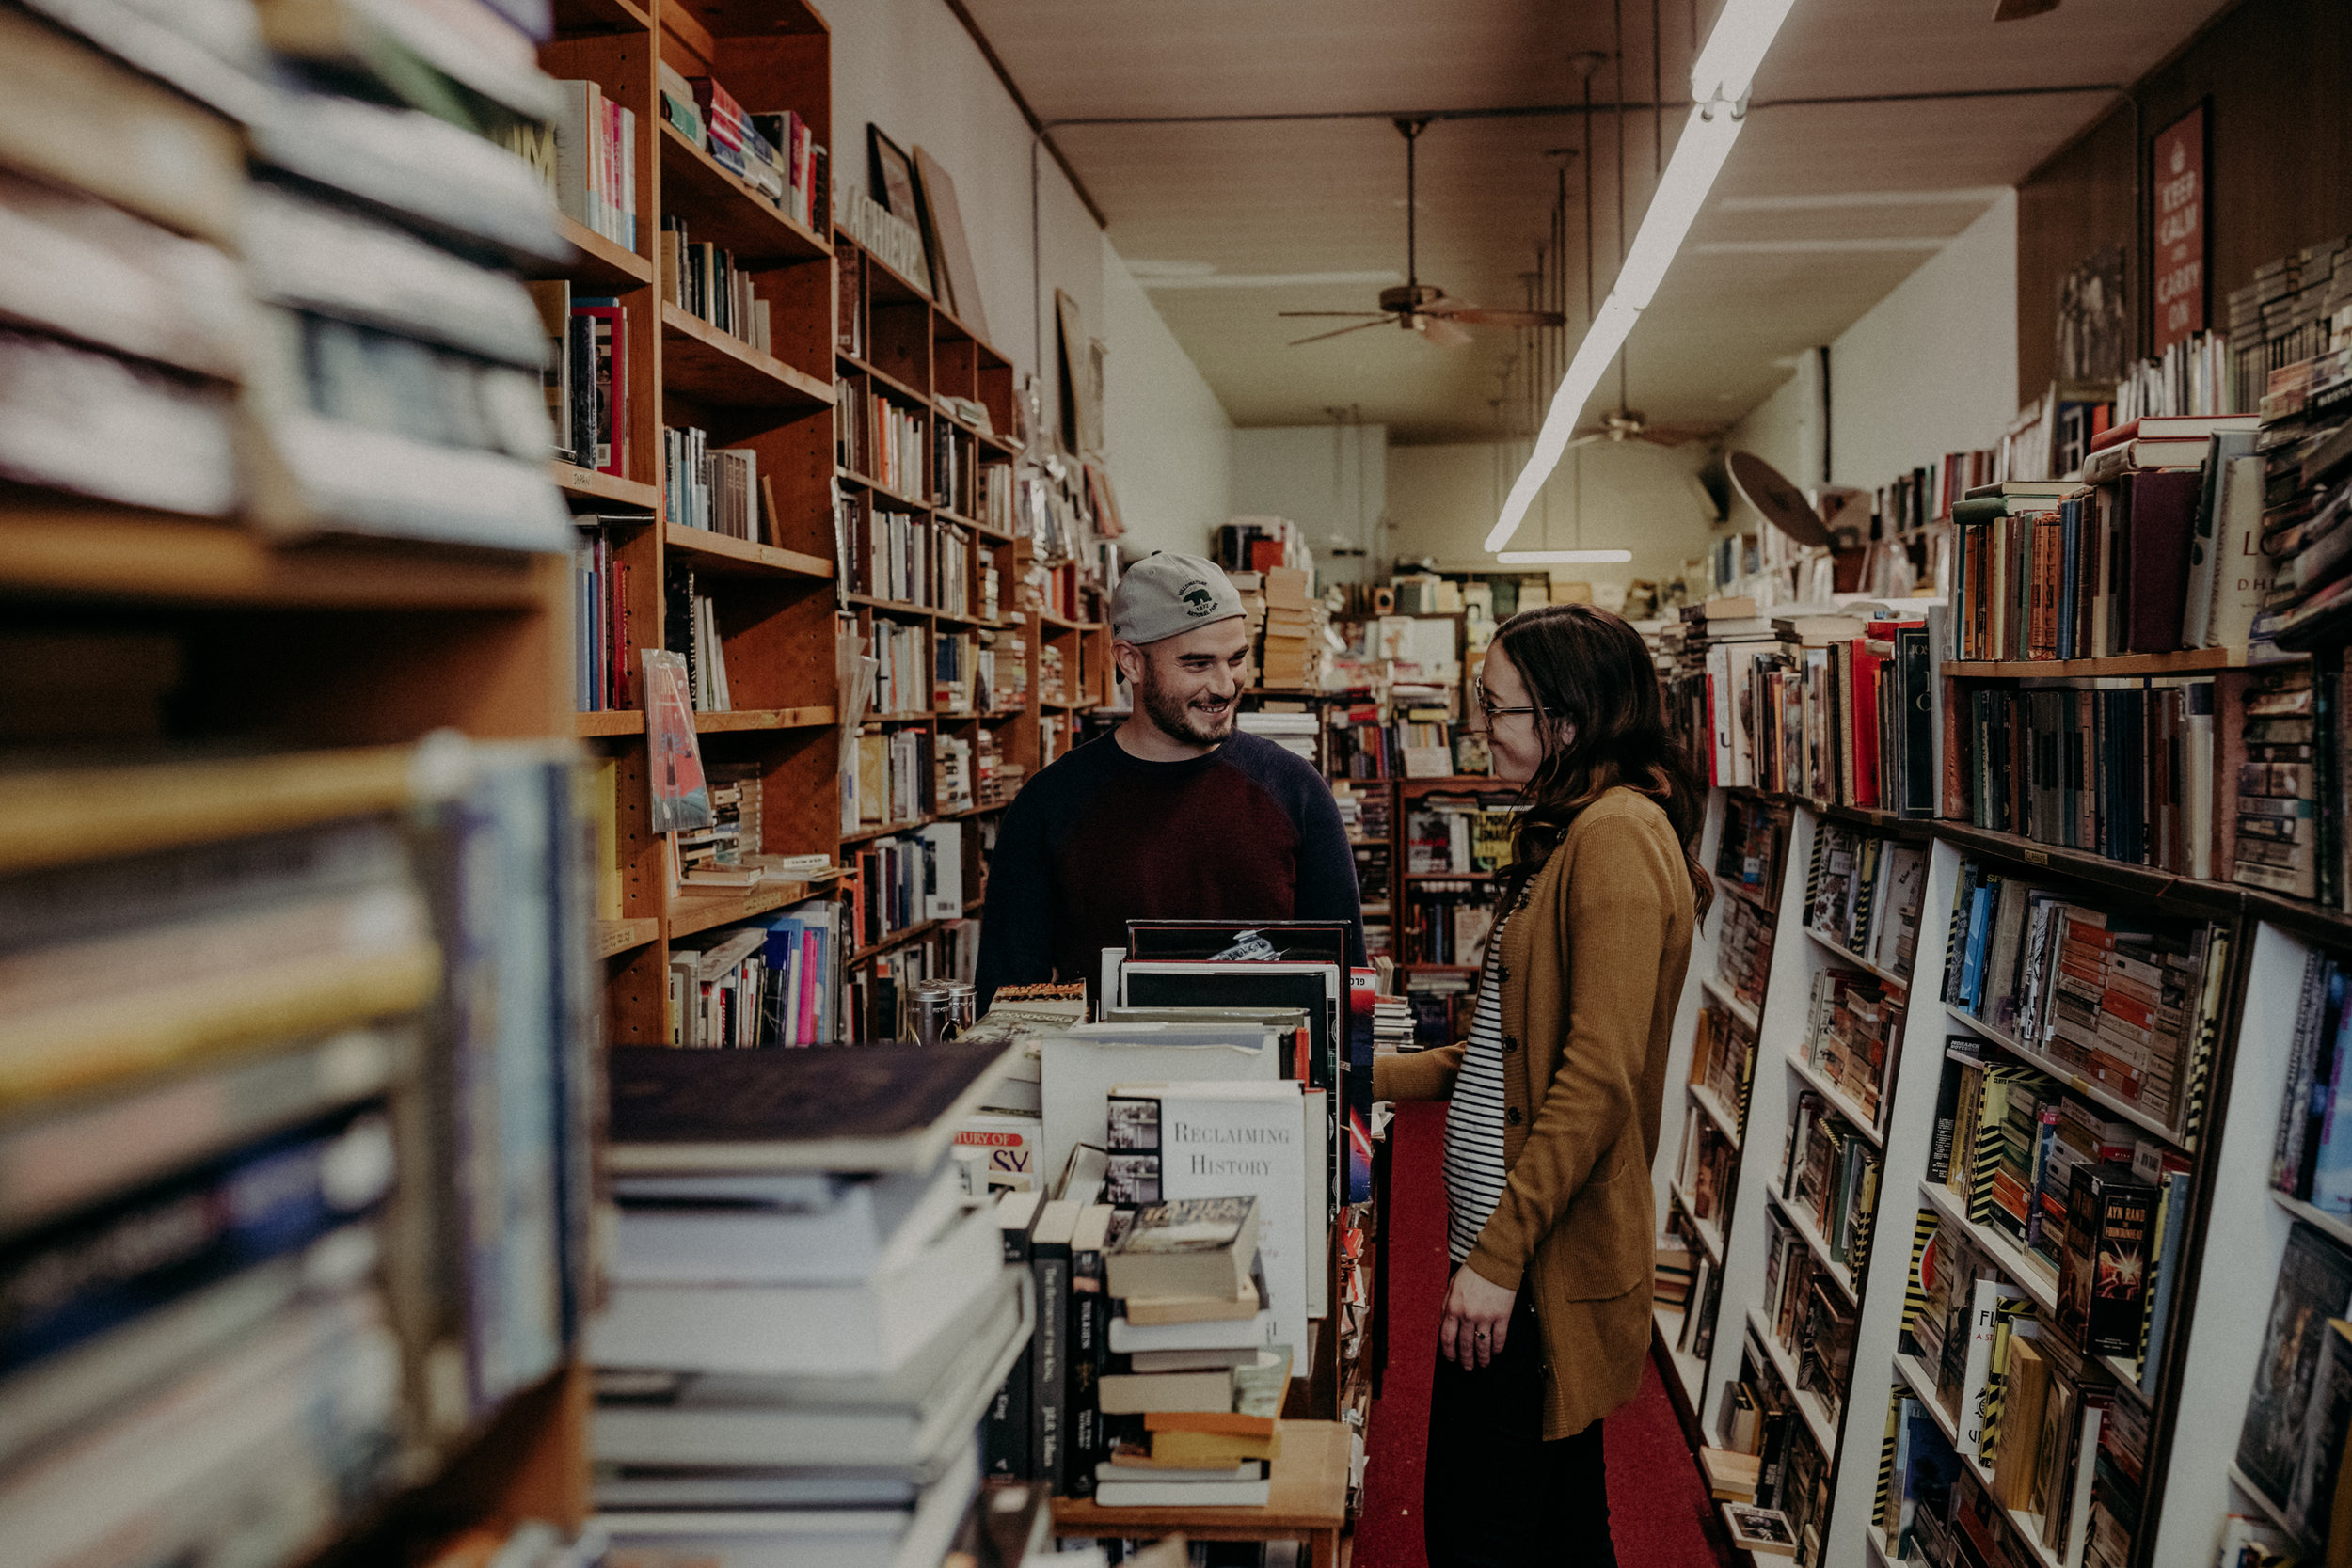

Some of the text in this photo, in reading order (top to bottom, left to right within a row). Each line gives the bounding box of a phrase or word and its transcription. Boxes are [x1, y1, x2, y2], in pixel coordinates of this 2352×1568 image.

[956, 1132, 1009, 1145] TURY OF
[1174, 1121, 1289, 1144] RECLAIMING
[991, 1149, 1029, 1173] SY
[1191, 1154, 1271, 1176] HISTORY
[2107, 1205, 2146, 1222] AYN RAND
